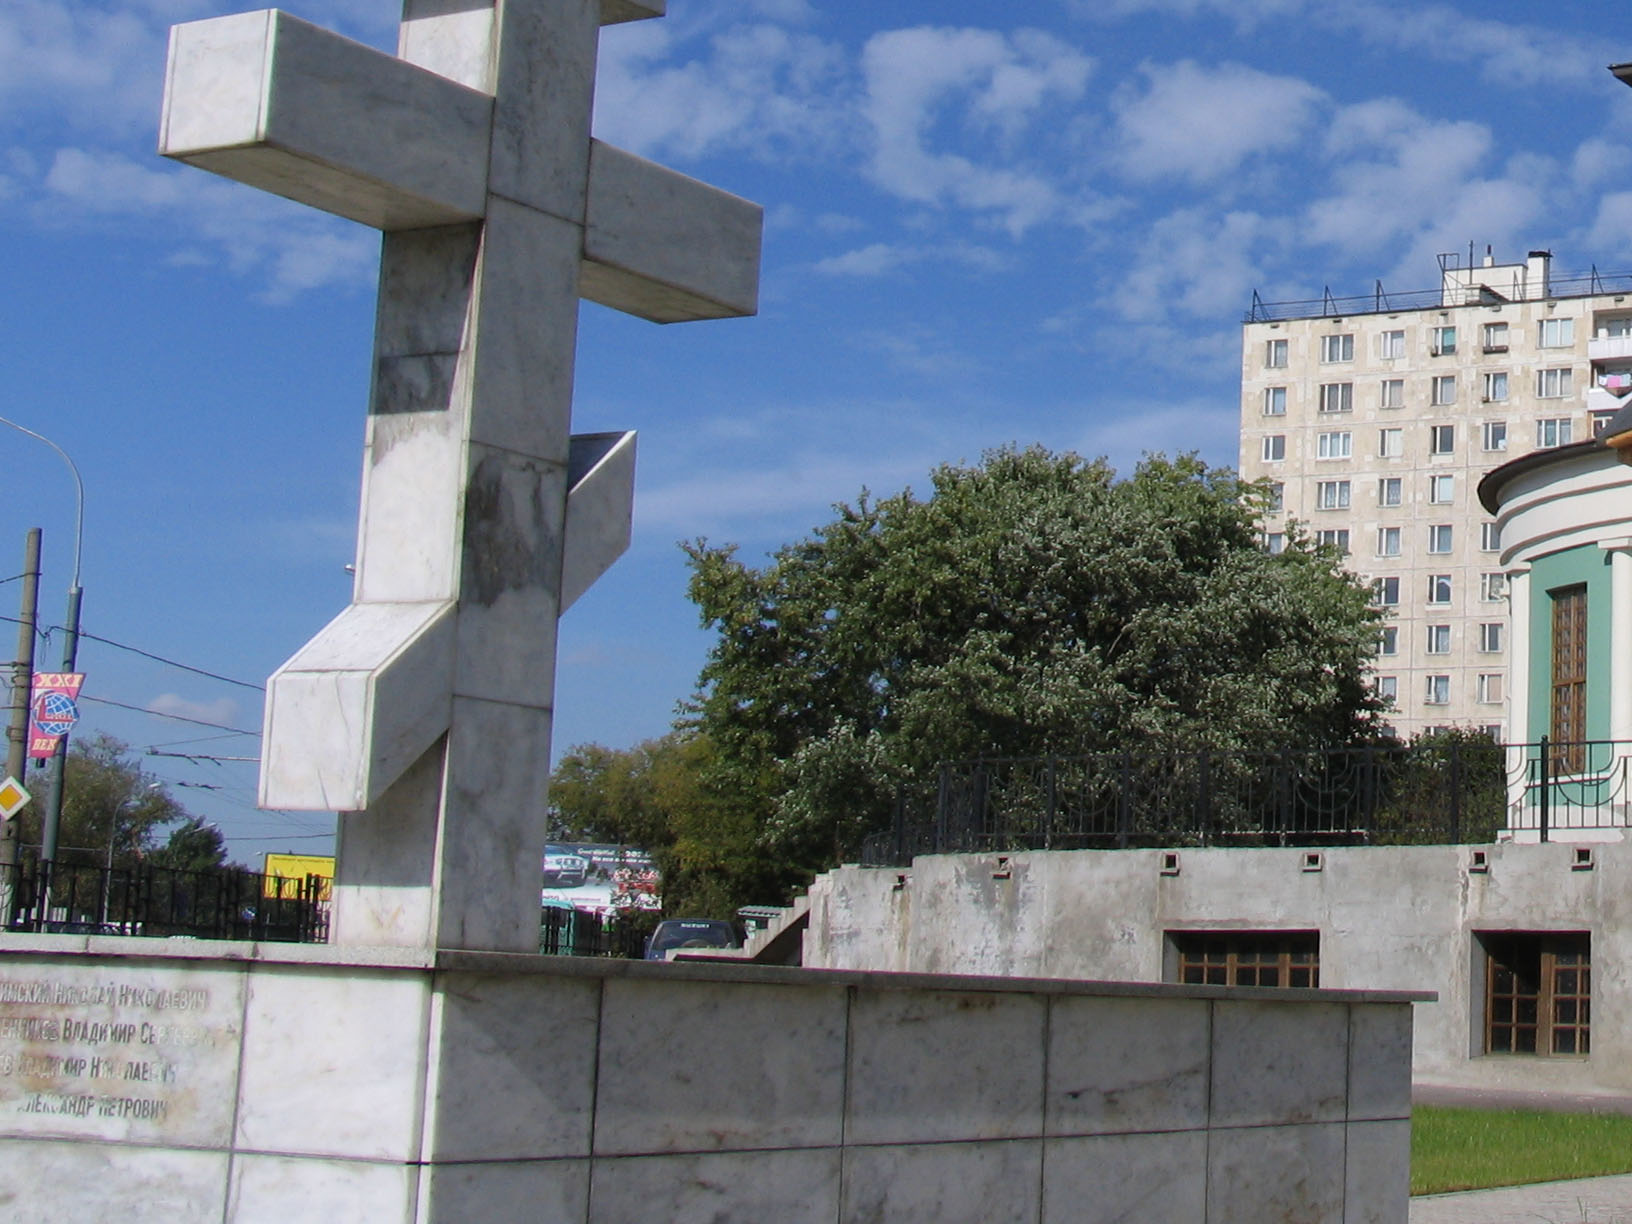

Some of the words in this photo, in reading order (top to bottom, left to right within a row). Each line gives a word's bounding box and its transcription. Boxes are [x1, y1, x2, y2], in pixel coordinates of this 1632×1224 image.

[118, 984, 207, 1009] НИКОЛАЕВИЧ
[62, 1018, 137, 1046] ВЛАДИМИР
[140, 1022, 216, 1047] СЕРЕЕВ
[90, 1056, 177, 1084] НИКЛАЕВИЧ
[99, 1096, 168, 1120] ПЕТРОВИЧ
